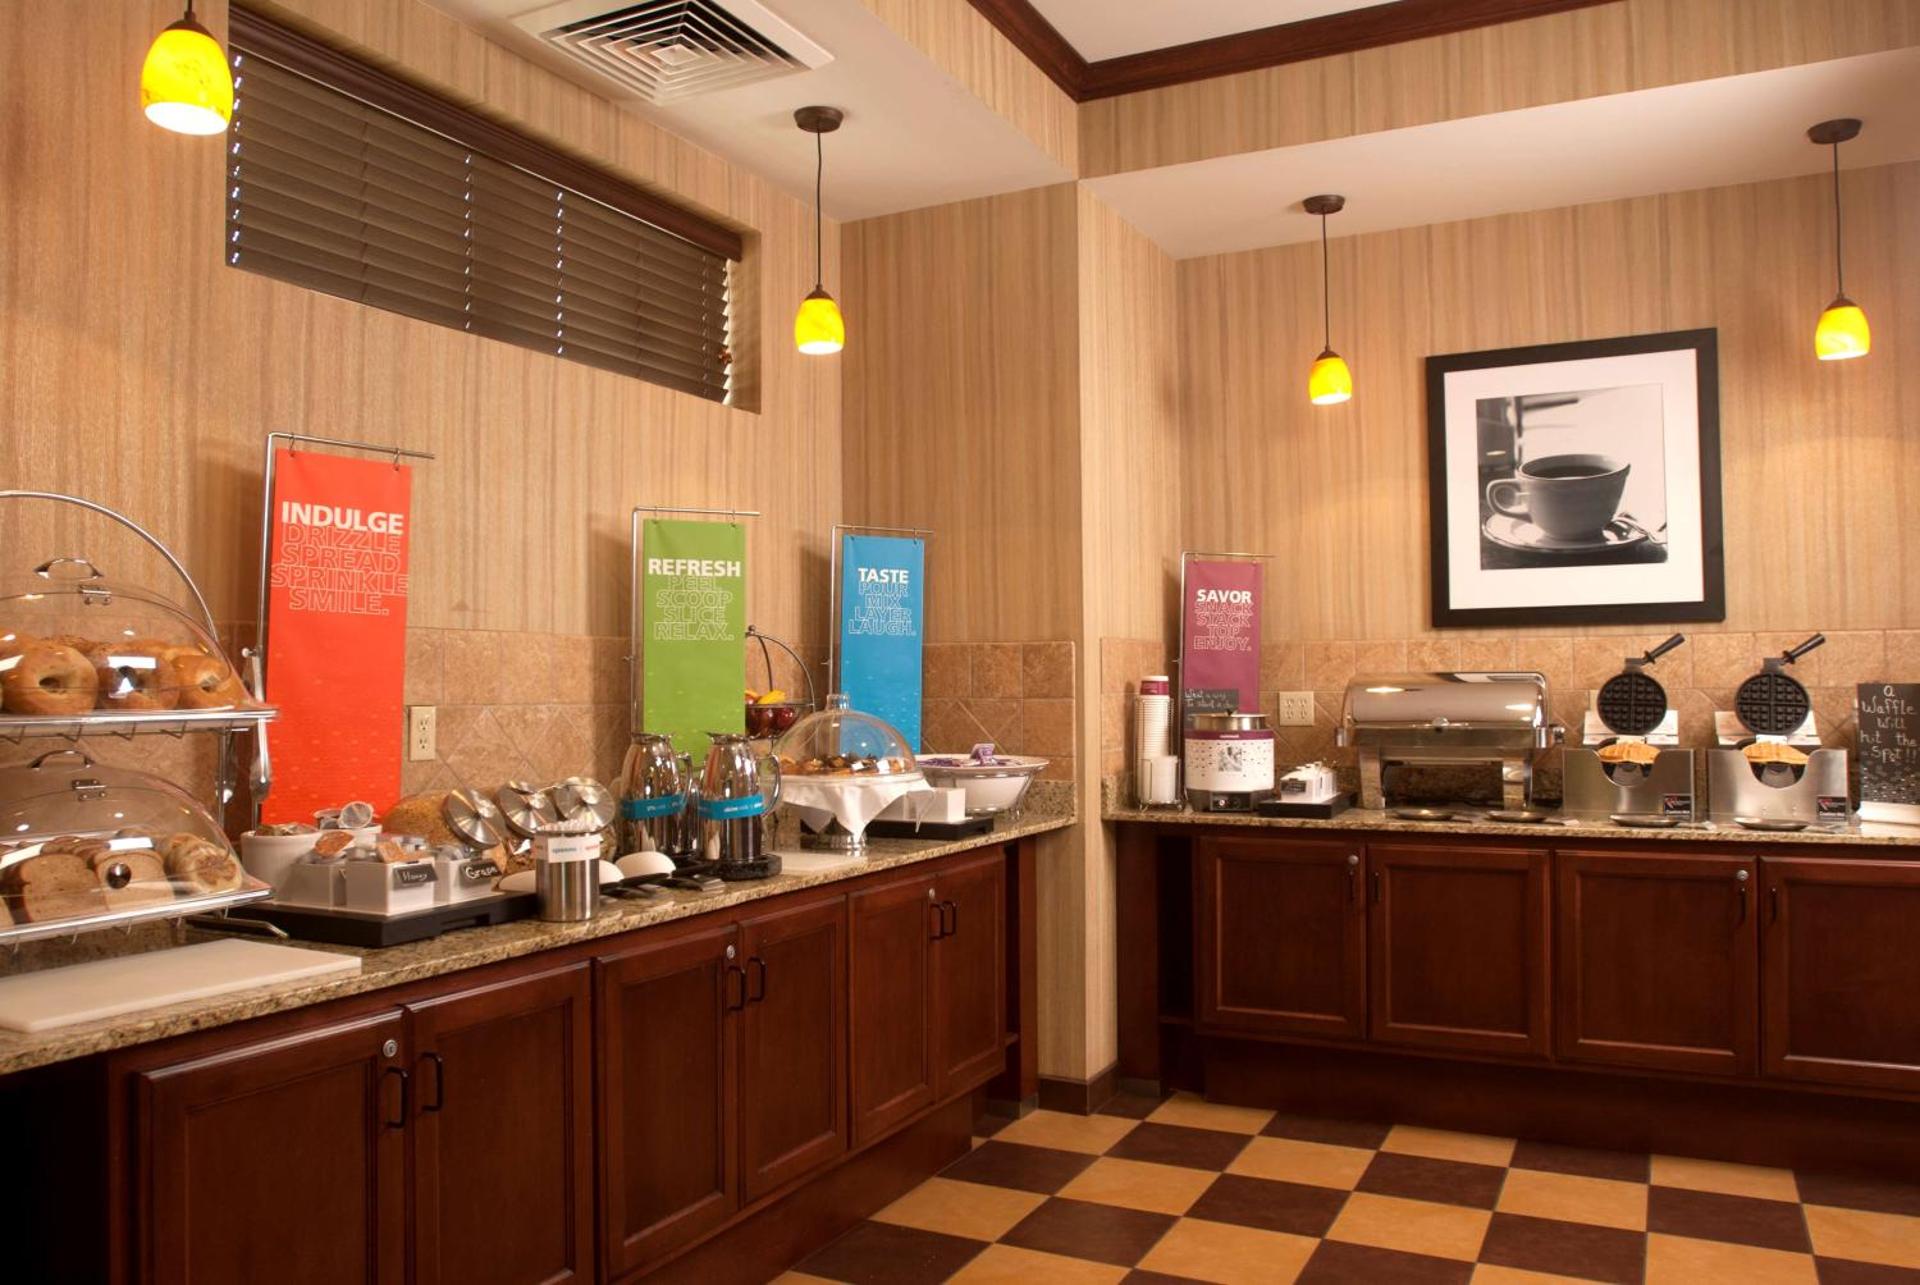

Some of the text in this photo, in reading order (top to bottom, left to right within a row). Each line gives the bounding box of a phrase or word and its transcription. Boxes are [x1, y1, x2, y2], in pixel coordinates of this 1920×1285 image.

[281, 501, 404, 535] INDULGE
[283, 523, 401, 555] DRIZZLE
[281, 542, 400, 574] SPREAD
[648, 558, 741, 577] REFRESH
[858, 567, 910, 584] TASTE
[271, 562, 409, 596] SPRINKLE
[668, 575, 719, 591] PEEL
[655, 588, 733, 609] SCOOP
[858, 581, 909, 598] POUR
[1196, 588, 1253, 604] SAVOR
[288, 586, 390, 615] SMILE.
[864, 593, 902, 609] MIX
[1194, 601, 1254, 617] SNACK
[663, 605, 727, 624] SLICE
[854, 606, 912, 623] LAYER
[1195, 612, 1251, 628] STACK
[654, 621, 735, 641] RELAX.
[848, 618, 917, 636] LAUGH.
[1206, 624, 1241, 639] TOP
[1193, 635, 1252, 651] ENJOY.
[1861, 695, 1918, 715] Waffle
[1860, 729, 1918, 747] hit the
